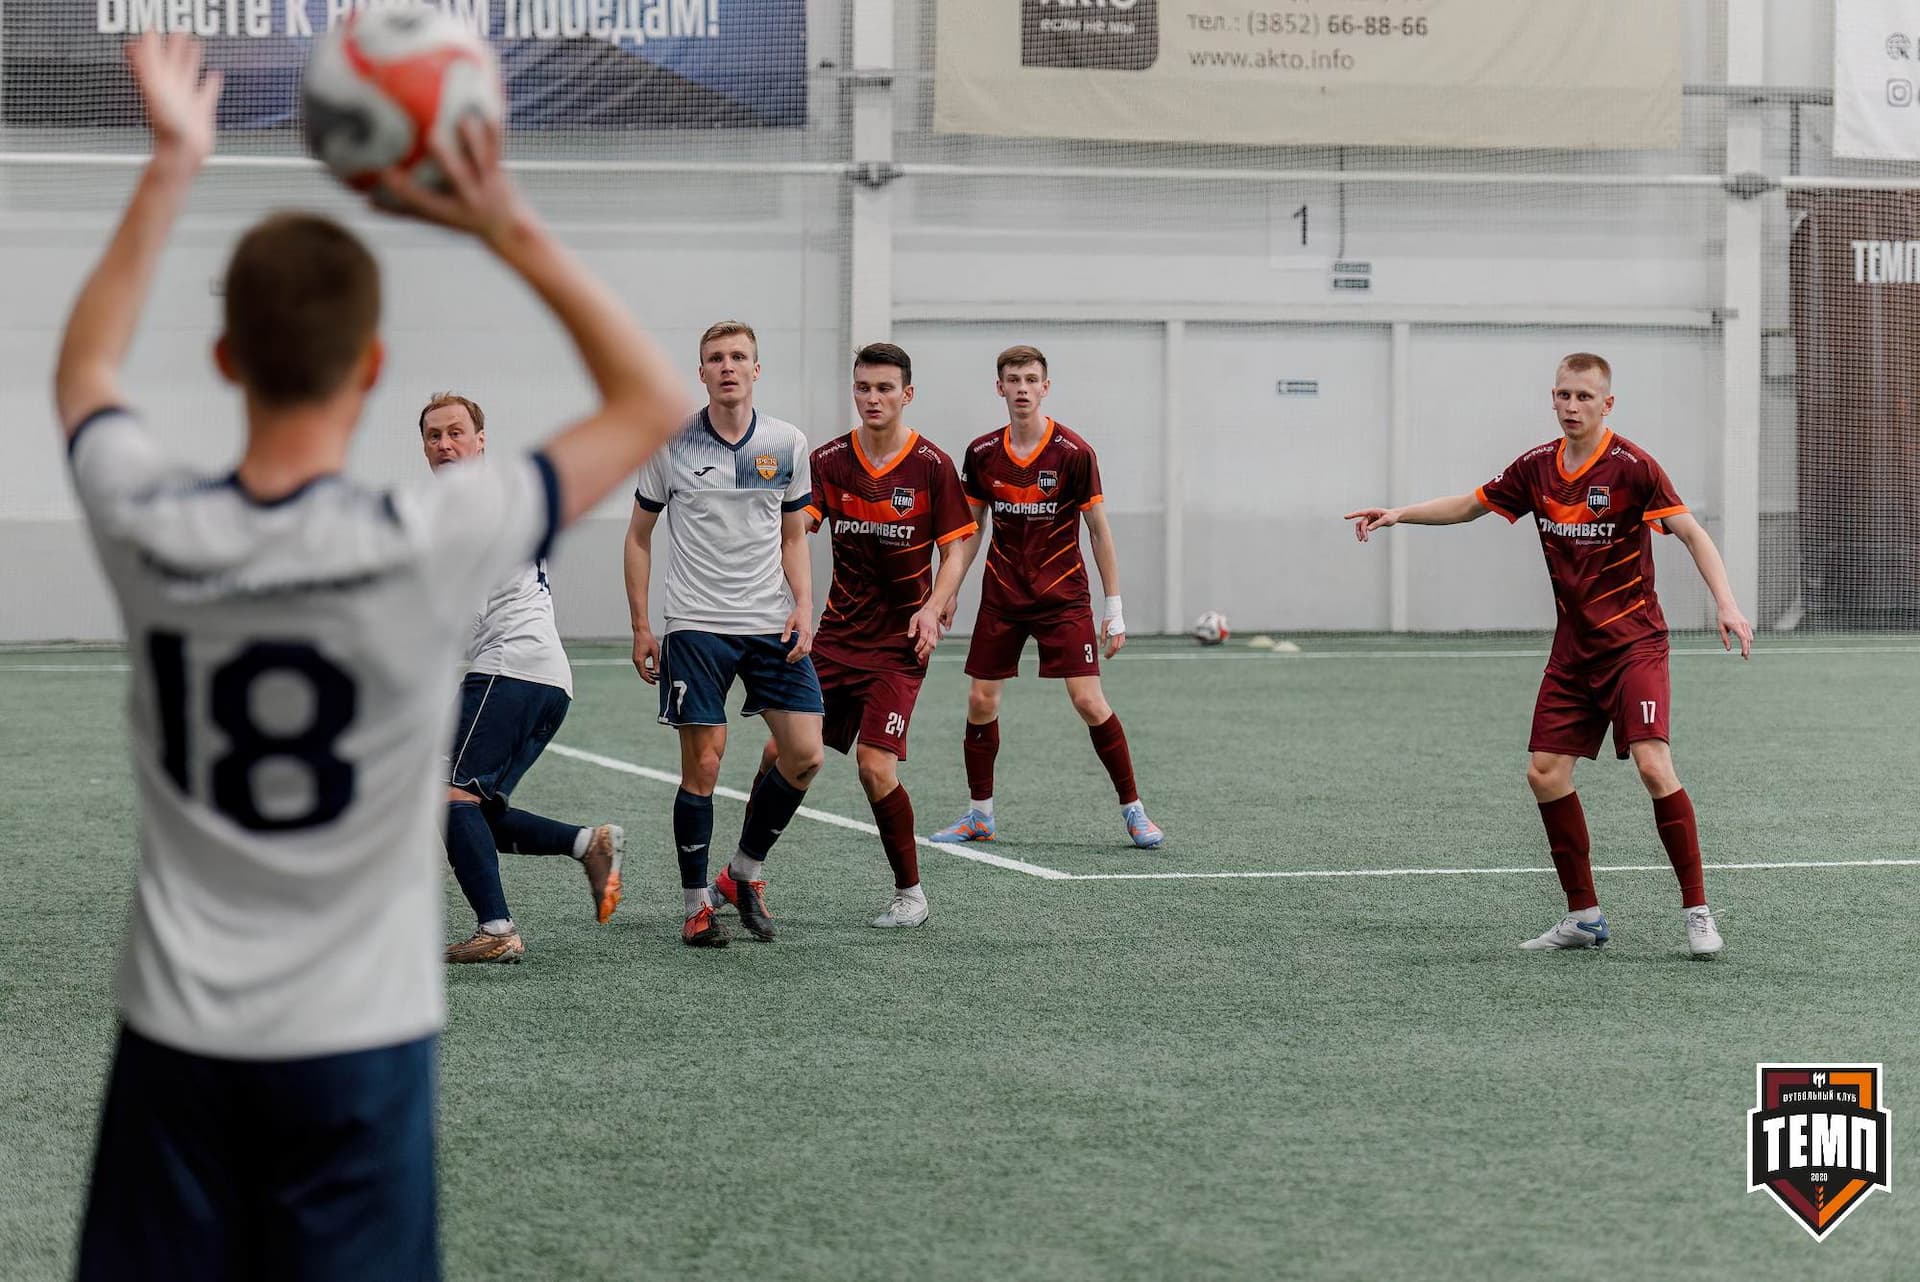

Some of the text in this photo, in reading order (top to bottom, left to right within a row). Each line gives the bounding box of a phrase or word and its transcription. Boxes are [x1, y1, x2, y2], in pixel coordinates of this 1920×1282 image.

[1187, 12, 1429, 36] тел.: (3852) 66-88-66
[1188, 49, 1356, 70] www.akto.info
[1293, 204, 1308, 246] 1
[893, 495, 913, 507] ТЕМП
[1589, 494, 1608, 506] ТЕМП
[834, 519, 915, 540] ПРОДИНВЕСТ
[1538, 517, 1616, 538] ПРОДИНВЕСТ
[1084, 643, 1094, 664] 3
[672, 680, 688, 716] 7
[1640, 700, 1656, 725] 17
[144, 627, 359, 835] 18
[884, 711, 905, 738] 24
